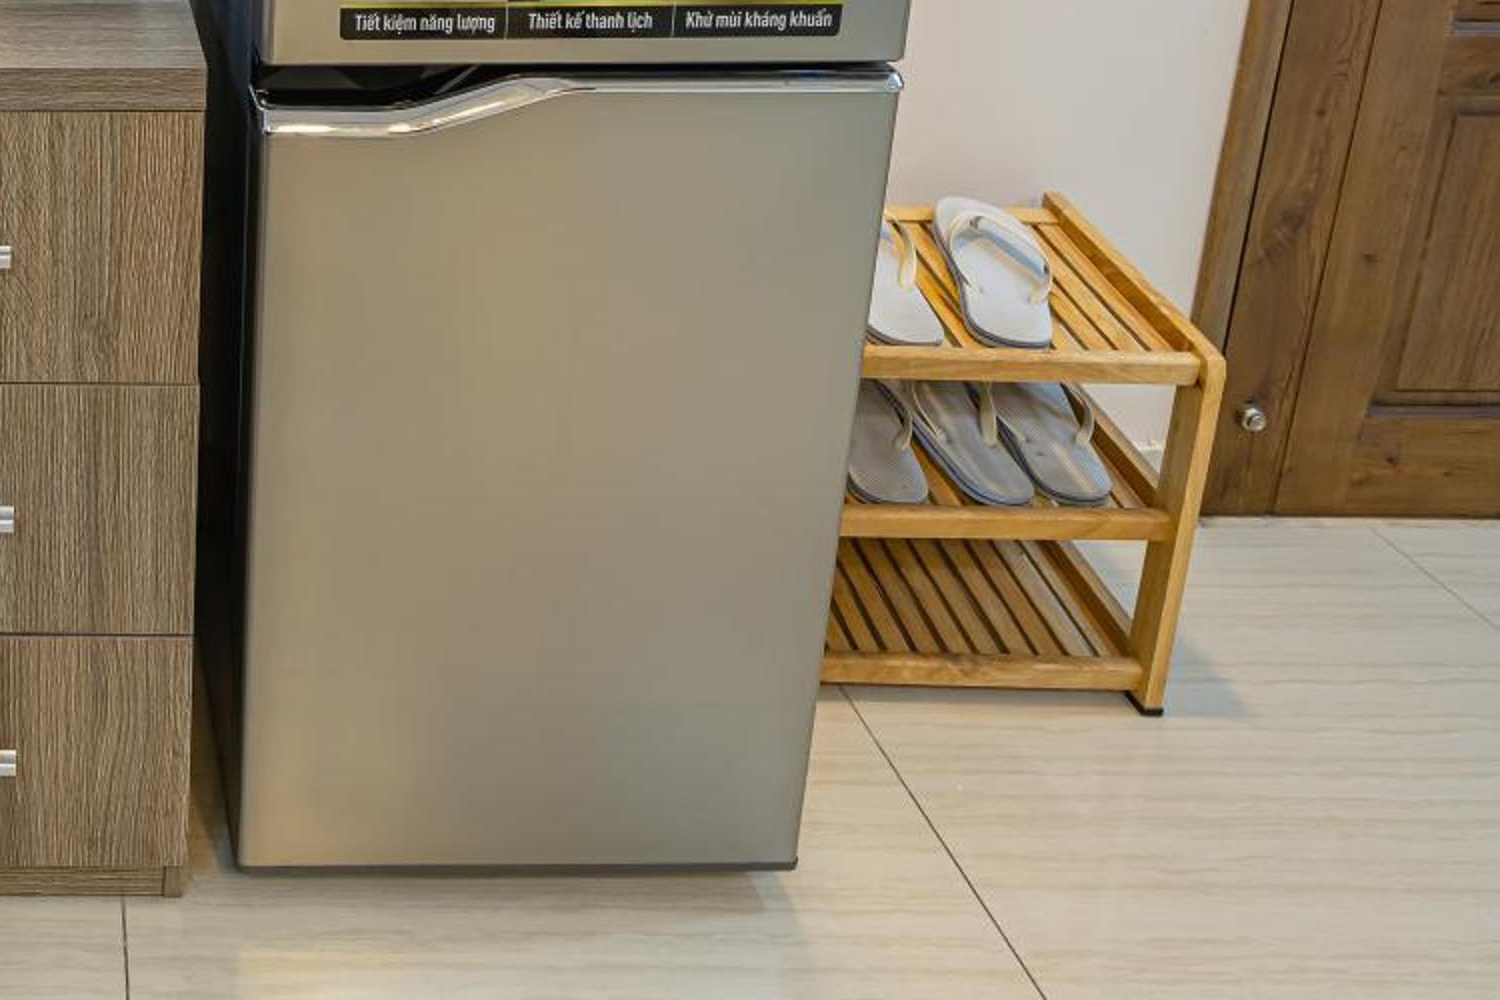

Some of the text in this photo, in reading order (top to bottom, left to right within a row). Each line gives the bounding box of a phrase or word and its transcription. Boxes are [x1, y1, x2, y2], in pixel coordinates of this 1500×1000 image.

[355, 11, 496, 35] Tiết kiệm năng lượng
[528, 10, 653, 33] Thiết kế thanh lịch
[715, 10, 742, 28] mùi
[744, 9, 787, 31] kháng
[789, 7, 834, 28] khuẩn
